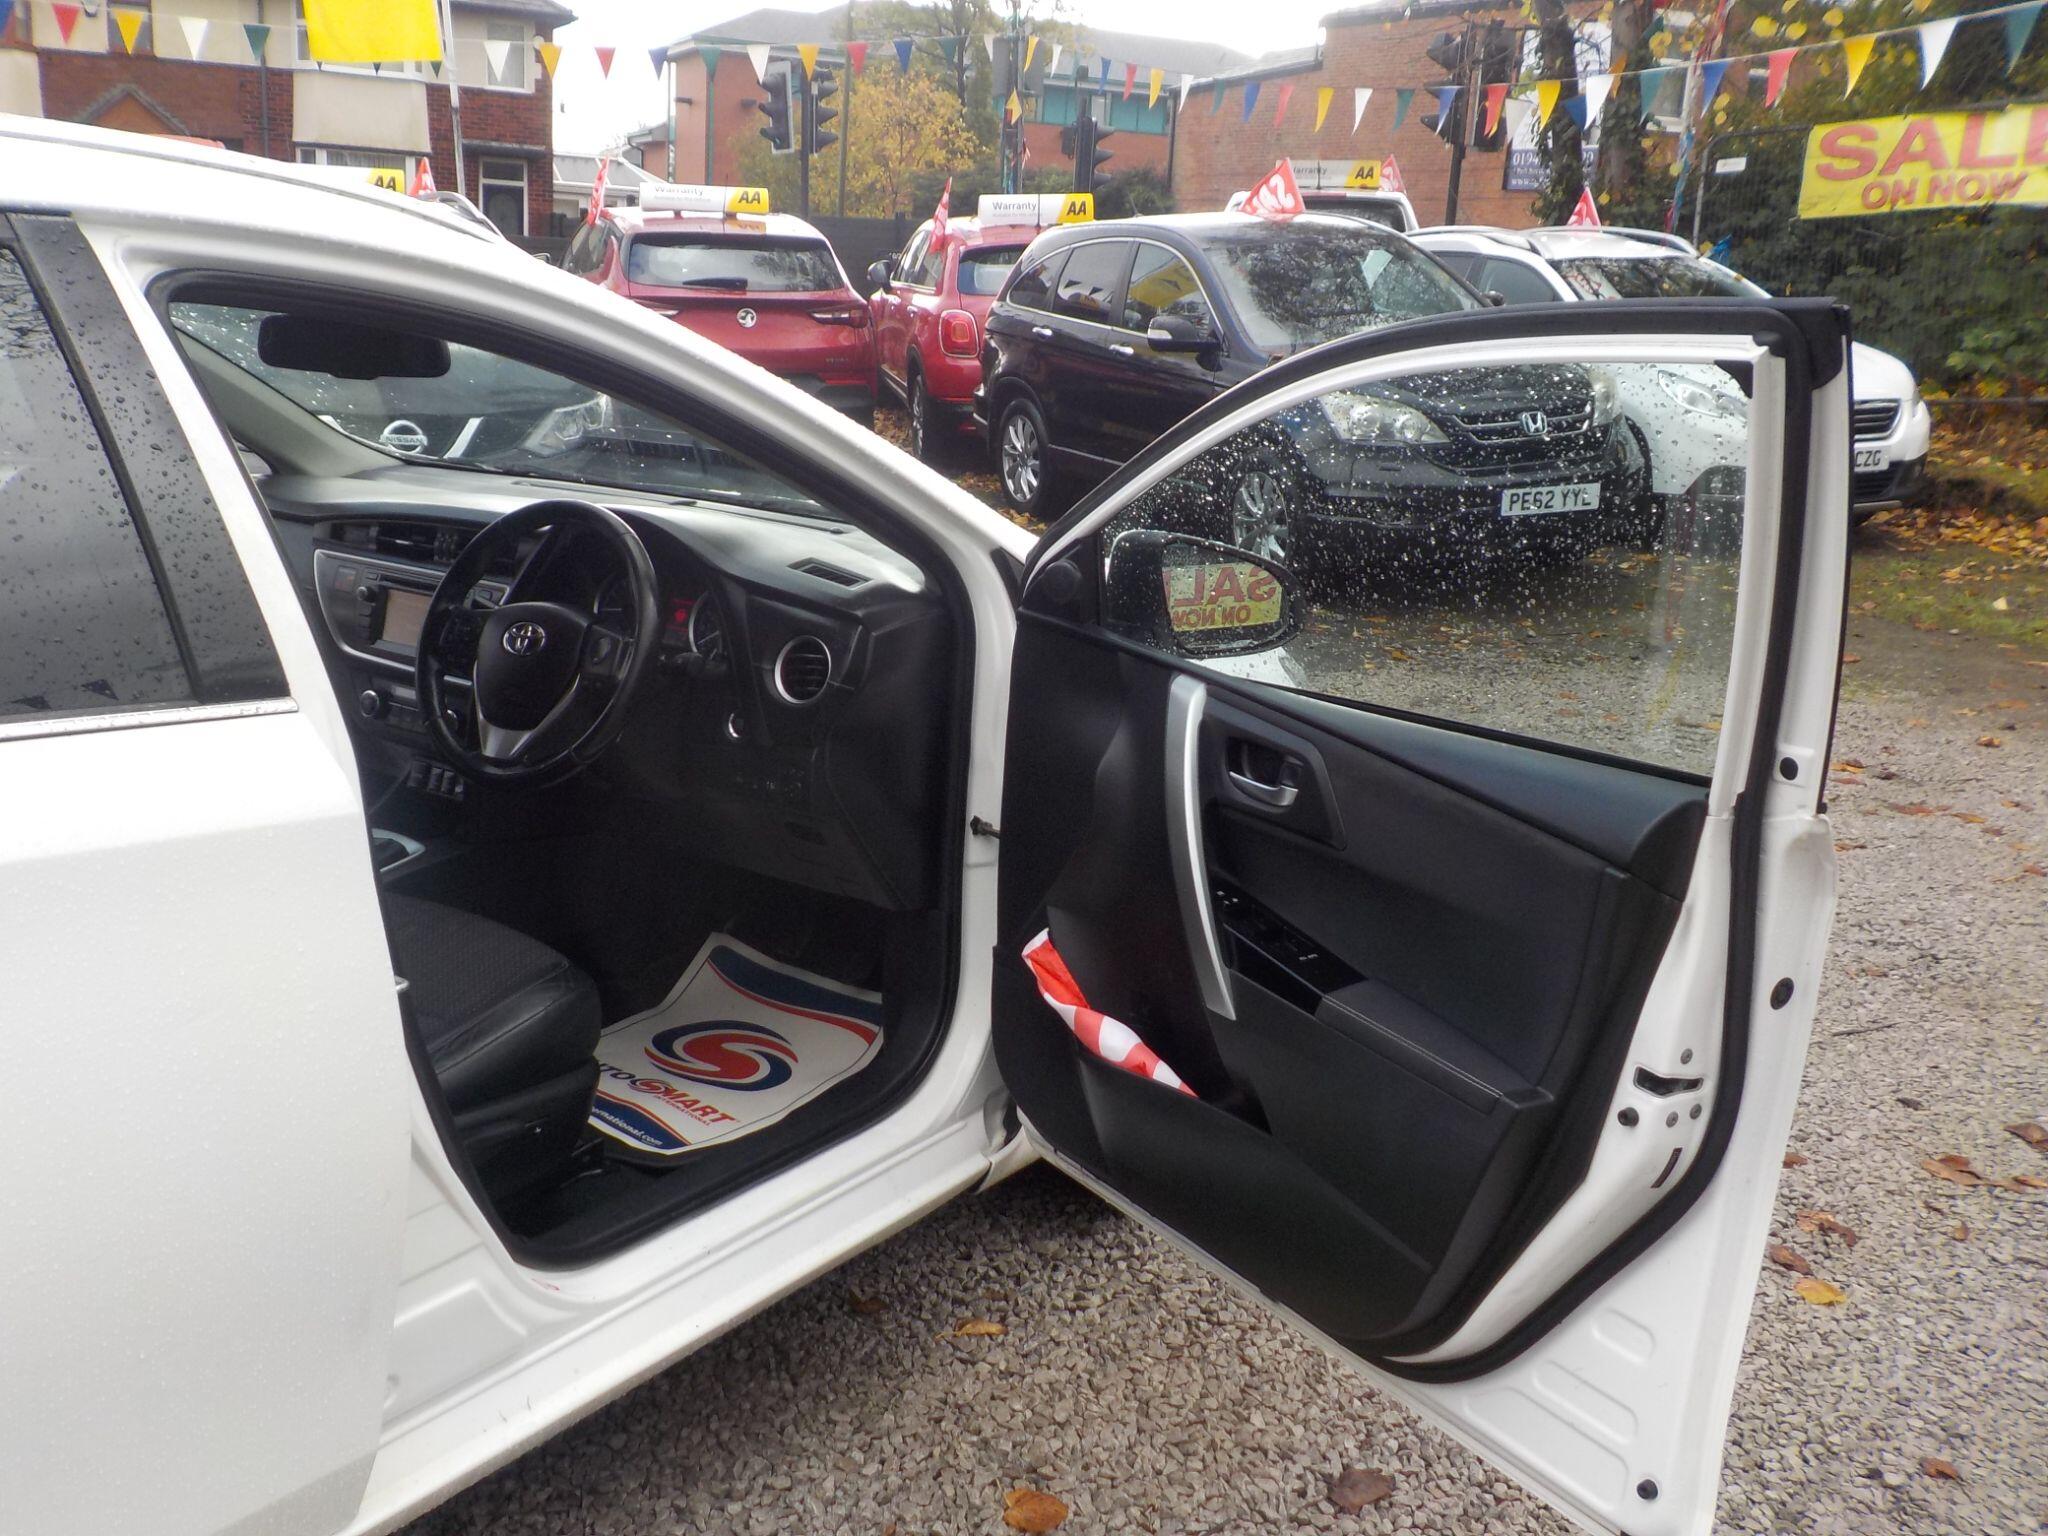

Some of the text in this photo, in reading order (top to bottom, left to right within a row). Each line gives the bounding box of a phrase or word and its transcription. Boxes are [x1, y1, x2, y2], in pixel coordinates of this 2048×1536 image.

[1355, 166, 1374, 179] AA
[374, 174, 396, 191] AA
[1861, 171, 2028, 209] ON NOW
[738, 190, 761, 204] AA
[992, 201, 1087, 216] Warranty AA
[386, 435, 422, 444] NISSAN
[1509, 490, 1555, 512] PE62
